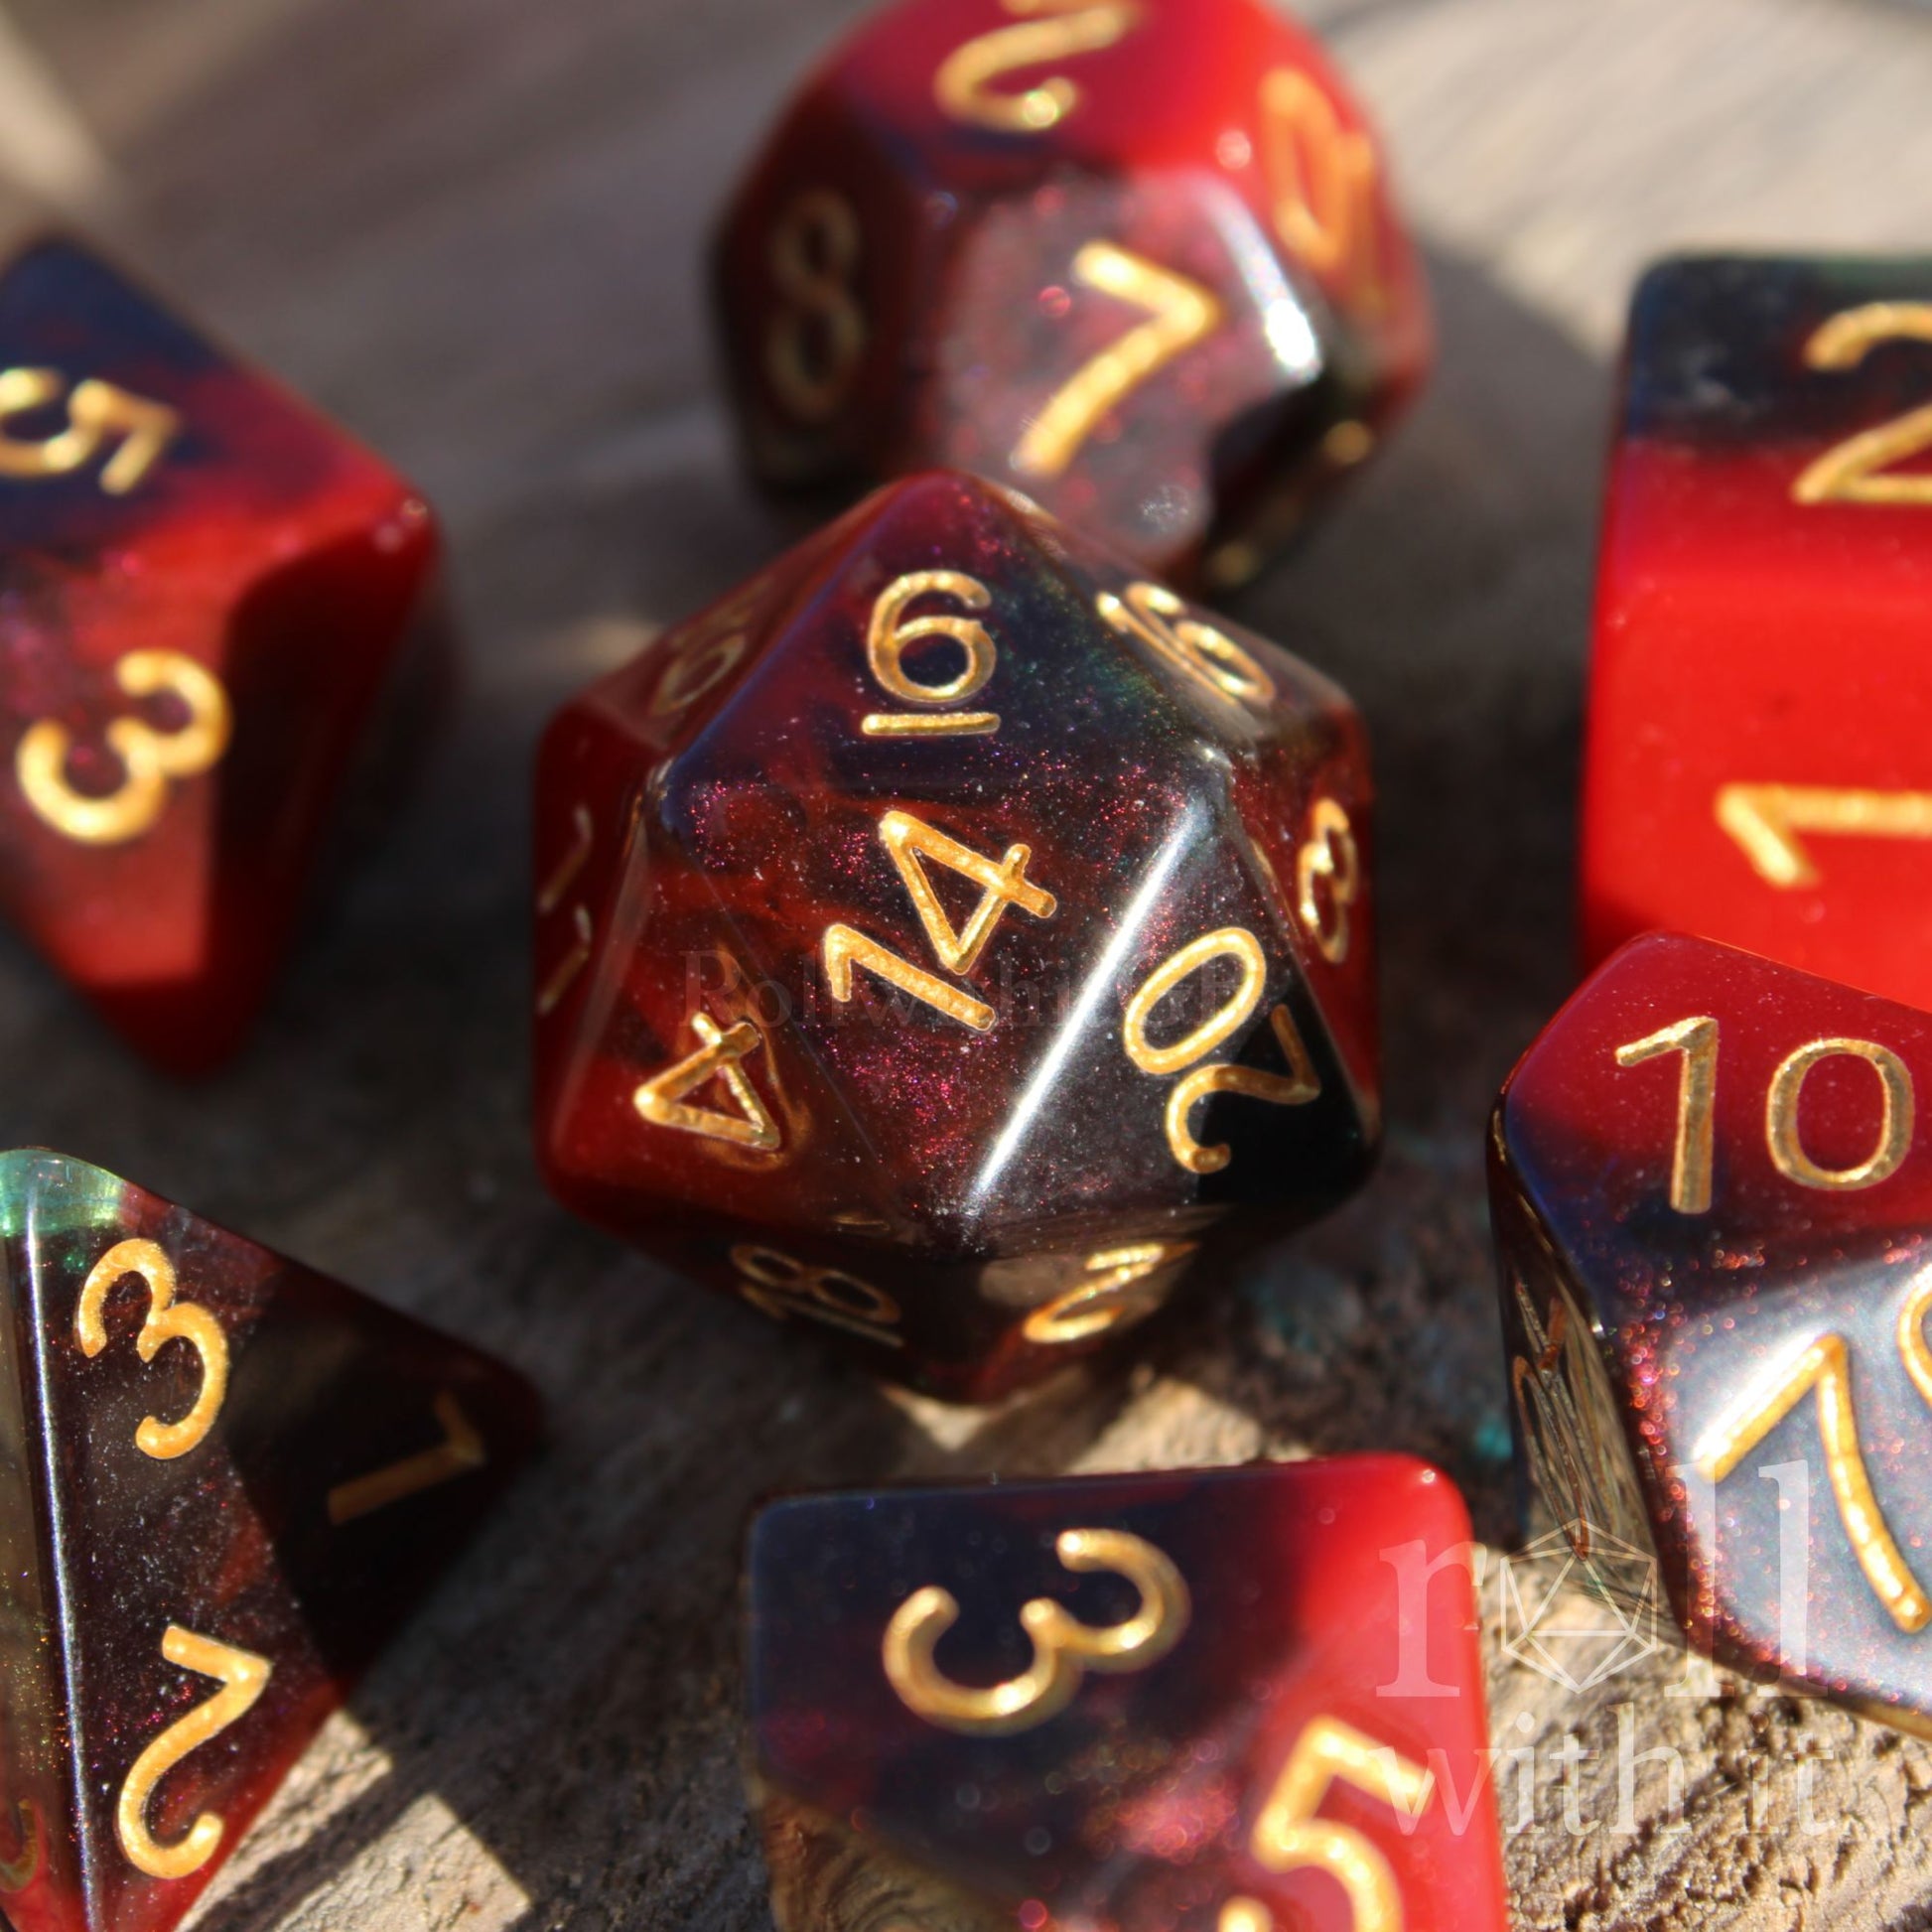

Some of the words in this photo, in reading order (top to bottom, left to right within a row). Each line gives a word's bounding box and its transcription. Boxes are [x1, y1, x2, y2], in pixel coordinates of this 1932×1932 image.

[0, 367, 179, 494] 5
[1011, 240, 1219, 477] 7
[1791, 302, 1932, 504] 2
[17, 647, 232, 844] 3
[862, 569, 1002, 736] 6
[823, 810, 1057, 1031] 14
[1714, 780, 1932, 890] 1
[634, 1011, 781, 1151] 4
[1124, 926, 1321, 1173] 20
[1614, 1015, 1915, 1213] 10
[75, 1237, 229, 1459] 3
[882, 1527, 1191, 1737] 3
[117, 1625, 272, 1878] 2
[1217, 1714, 1434, 1932] 5
